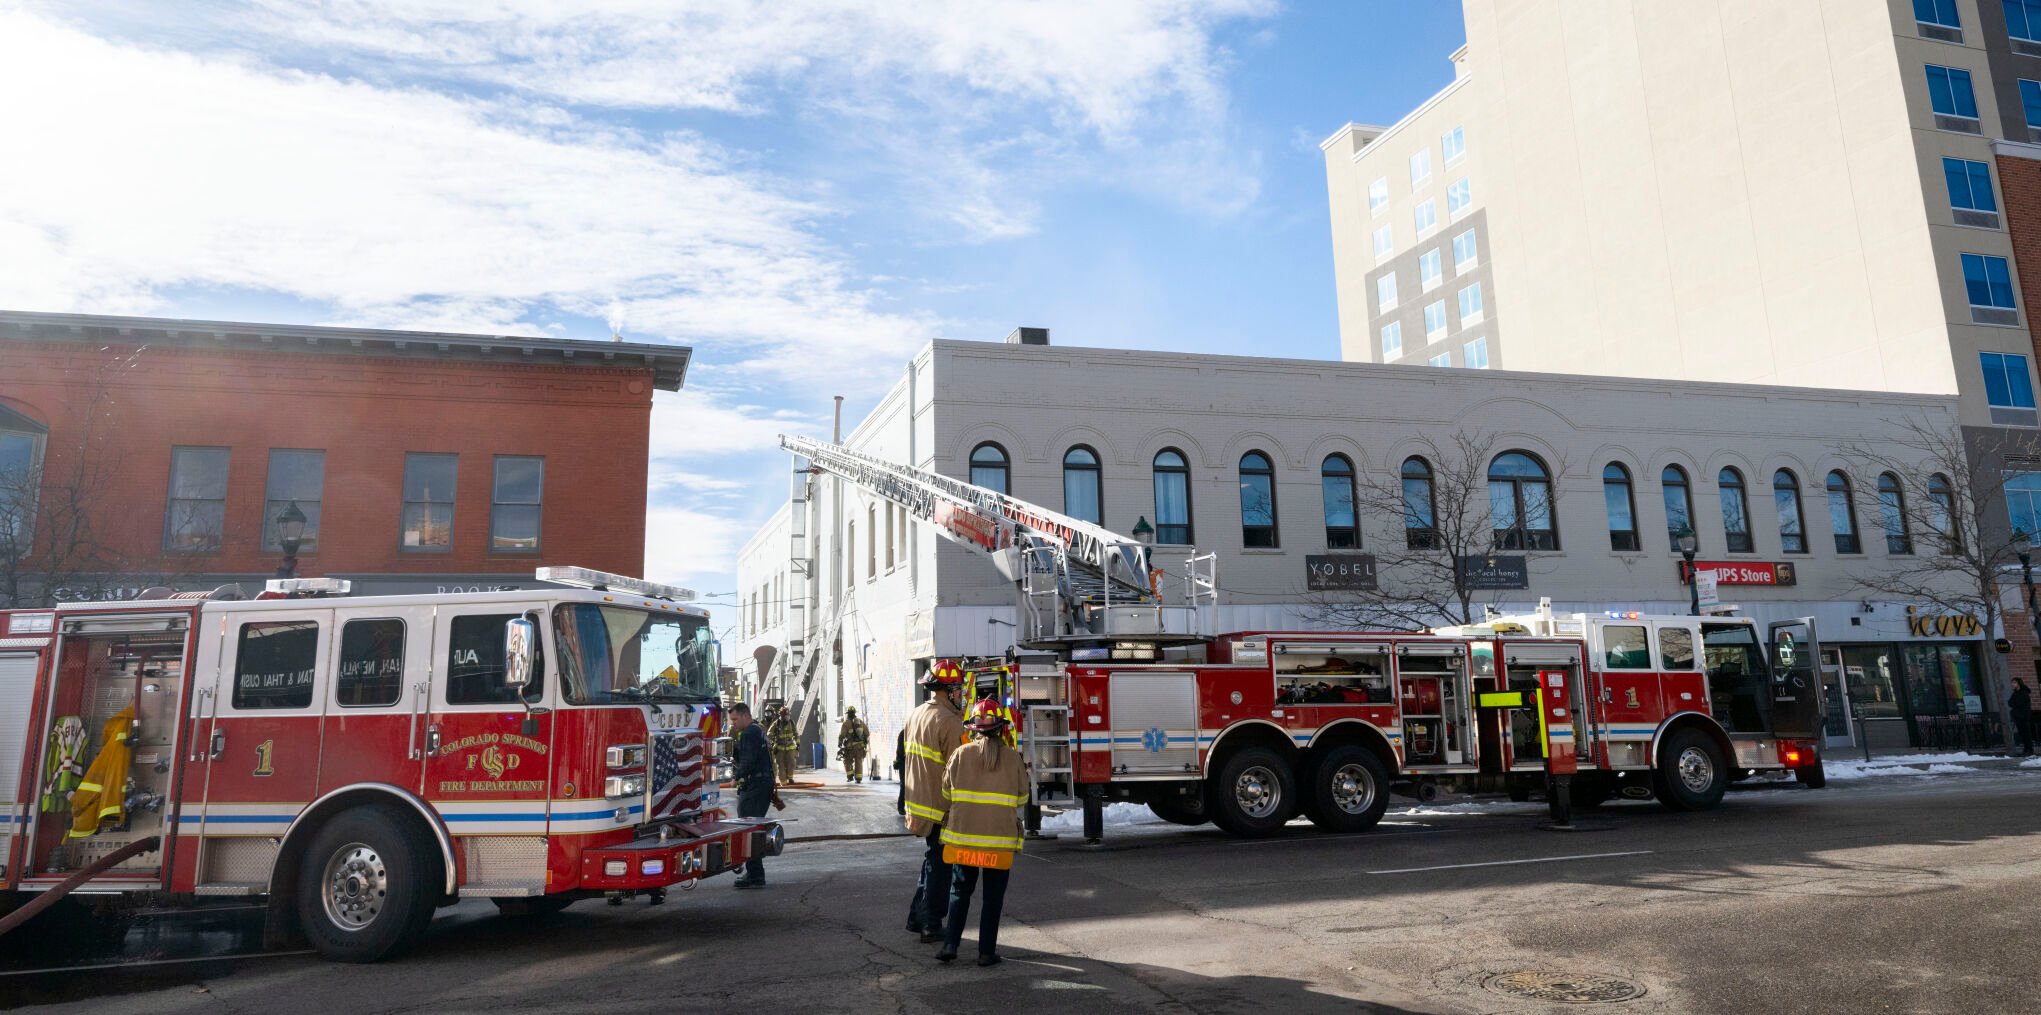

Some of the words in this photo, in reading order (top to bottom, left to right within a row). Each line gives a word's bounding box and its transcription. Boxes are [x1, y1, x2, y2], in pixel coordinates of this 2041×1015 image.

[1310, 563, 1373, 575] YOBEL
[1498, 568, 1519, 578] honey
[1714, 568, 1738, 581] UPS
[1741, 568, 1770, 582] Store
[1625, 687, 1640, 708] 1
[440, 733, 499, 756] COLORADO
[502, 733, 548, 755] SPRINGS
[252, 740, 274, 776] 1
[466, 754, 478, 770] F
[506, 753, 520, 769] D
[439, 780, 466, 792] FIRE
[470, 780, 545, 792] DEPARTMENT
[956, 848, 998, 866] FRANCO
